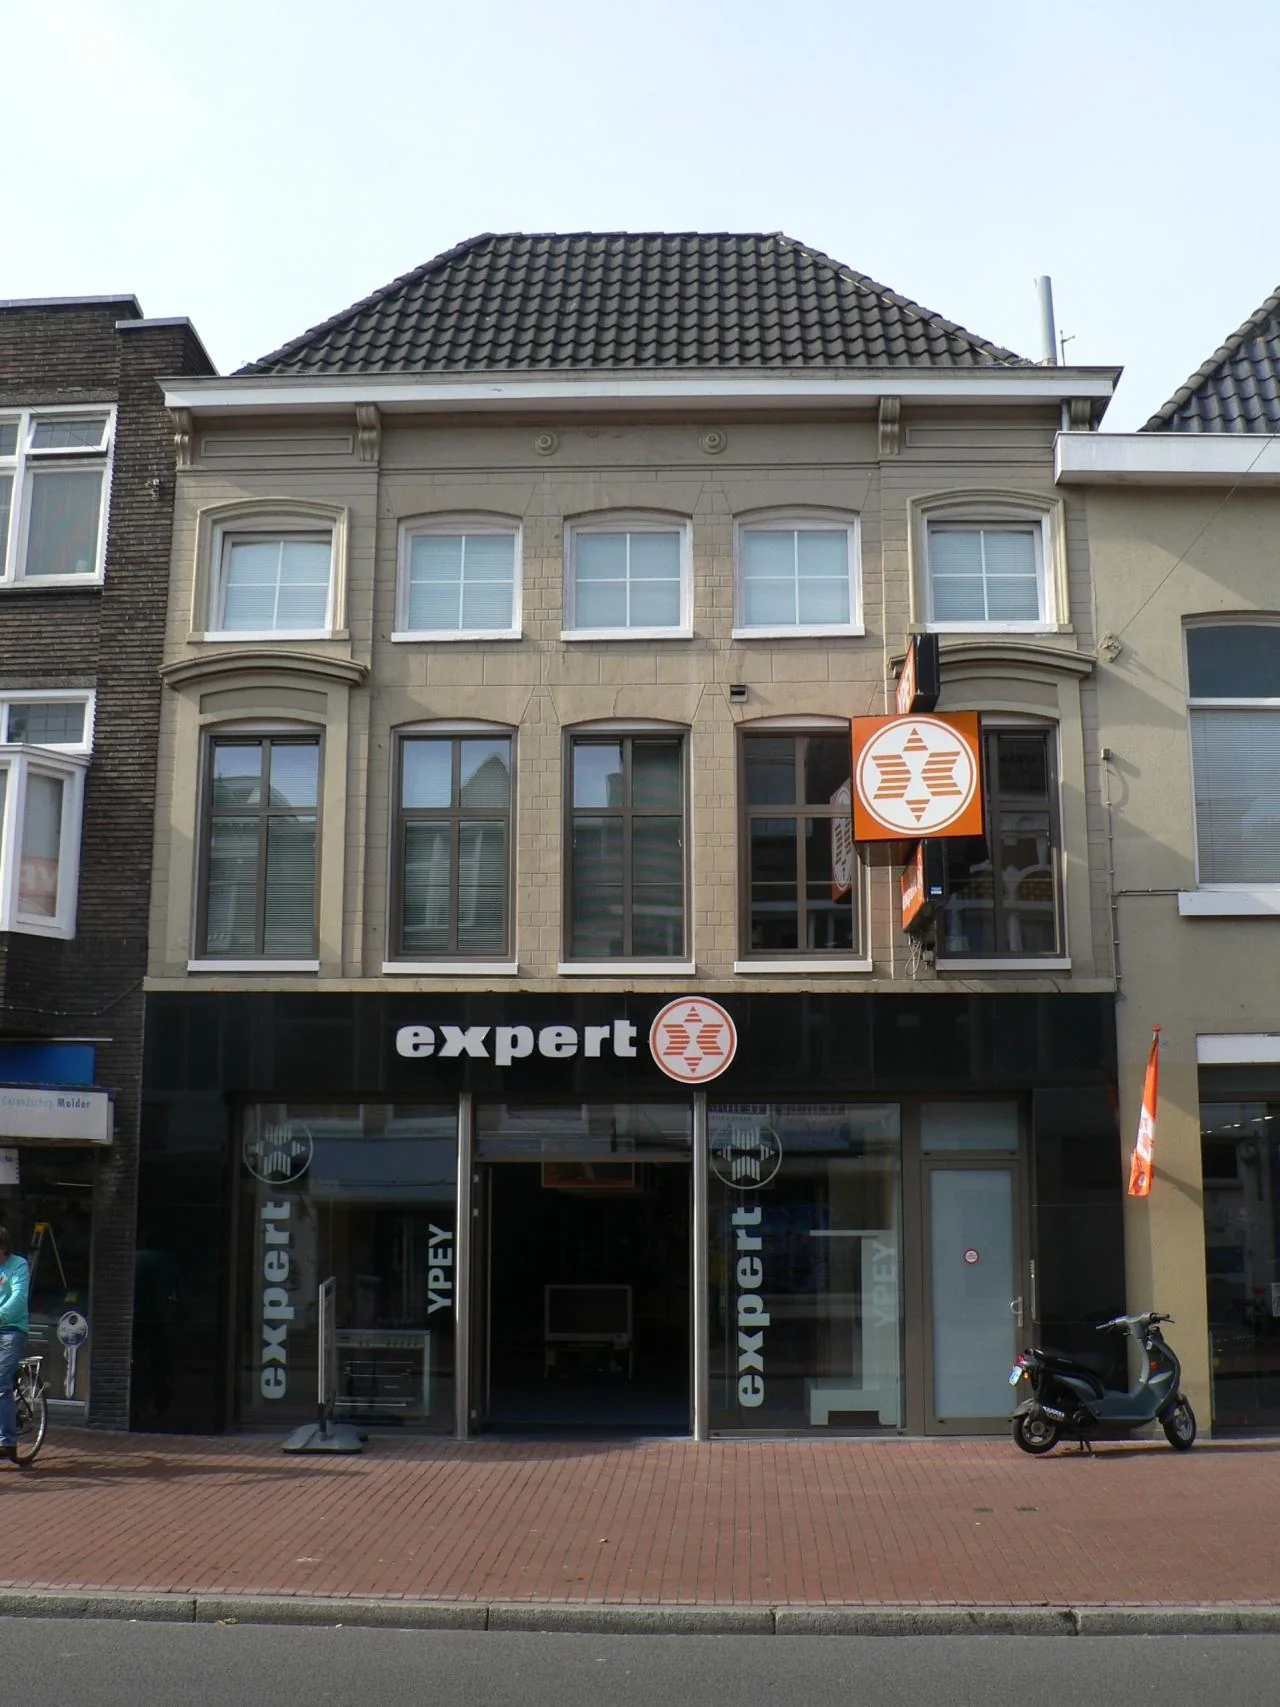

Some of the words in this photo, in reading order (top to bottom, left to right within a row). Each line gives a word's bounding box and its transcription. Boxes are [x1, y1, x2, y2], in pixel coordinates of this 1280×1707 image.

[396, 1020, 637, 1066] expert
[261, 1201, 295, 1399] expert
[427, 1223, 453, 1314] YPEY
[732, 1207, 770, 1407] expert
[872, 1240, 897, 1329] YPEY
